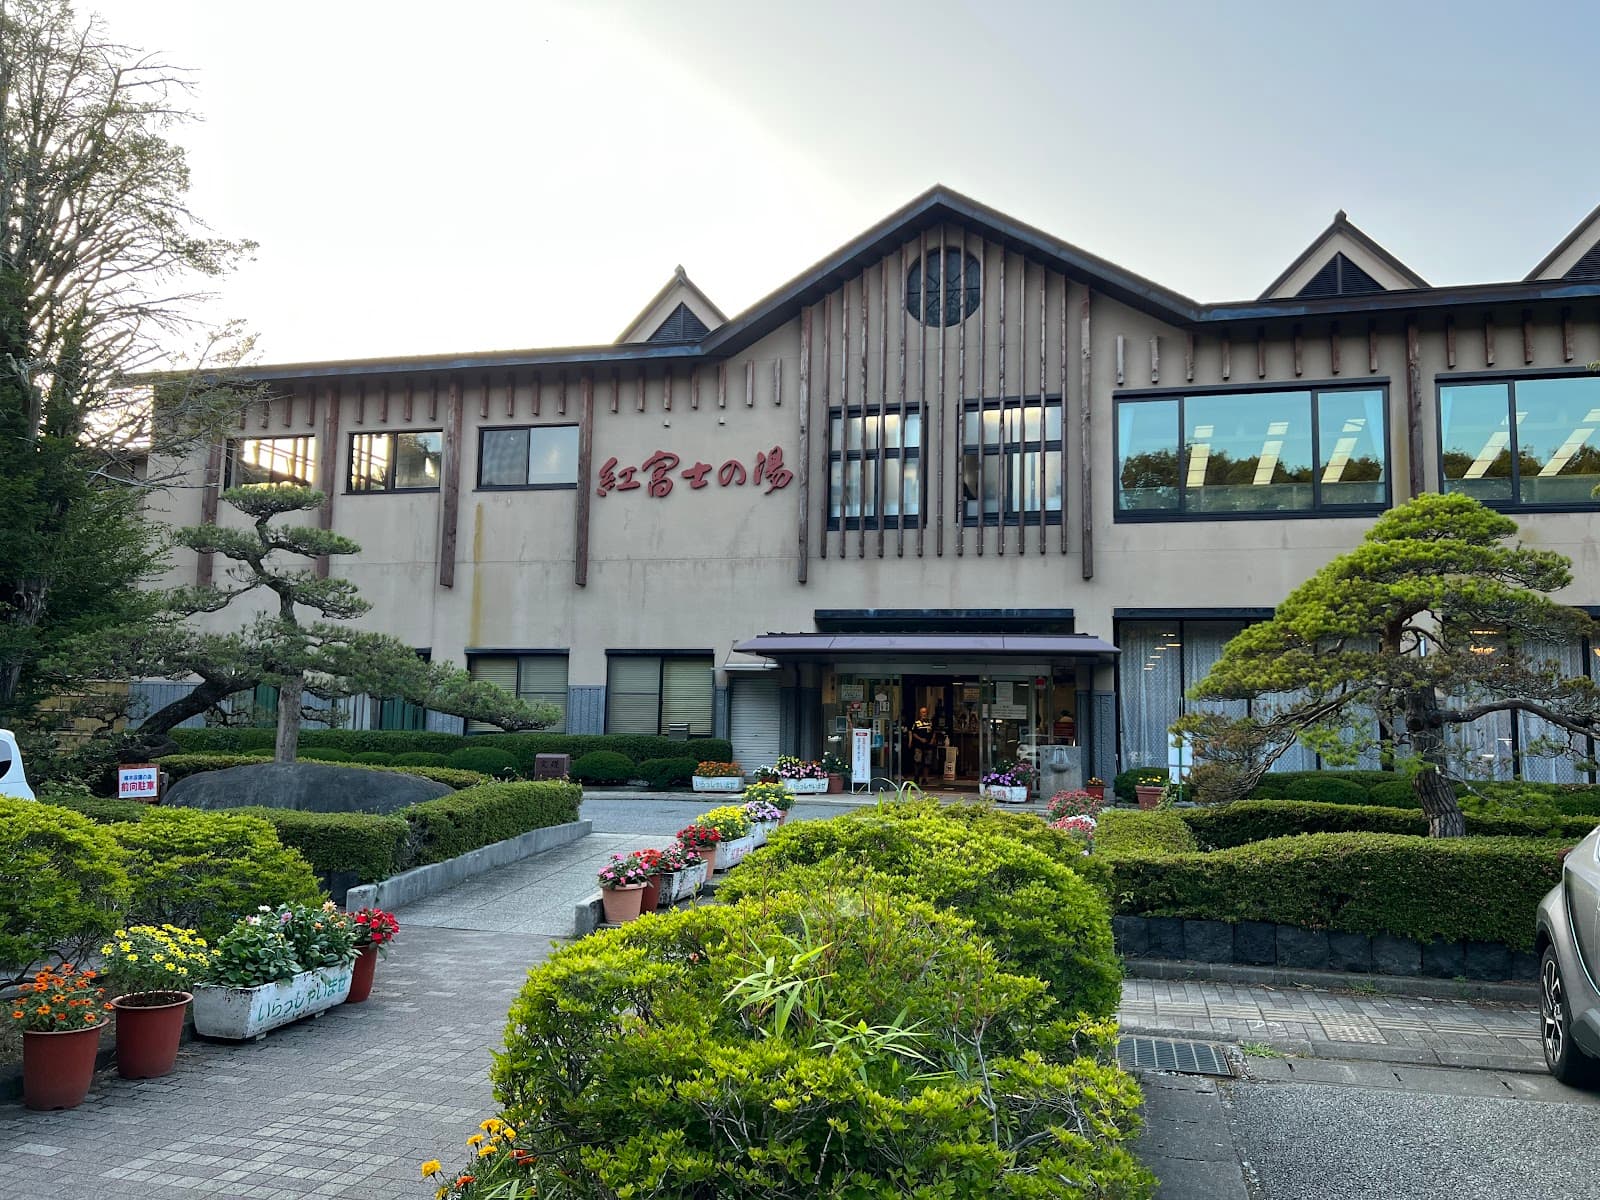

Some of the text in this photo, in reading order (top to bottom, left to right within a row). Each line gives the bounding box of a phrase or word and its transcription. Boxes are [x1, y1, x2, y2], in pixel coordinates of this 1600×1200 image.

[597, 445, 793, 497] 紅富士の湯
[257, 974, 348, 1022] いらっしゃいませ
